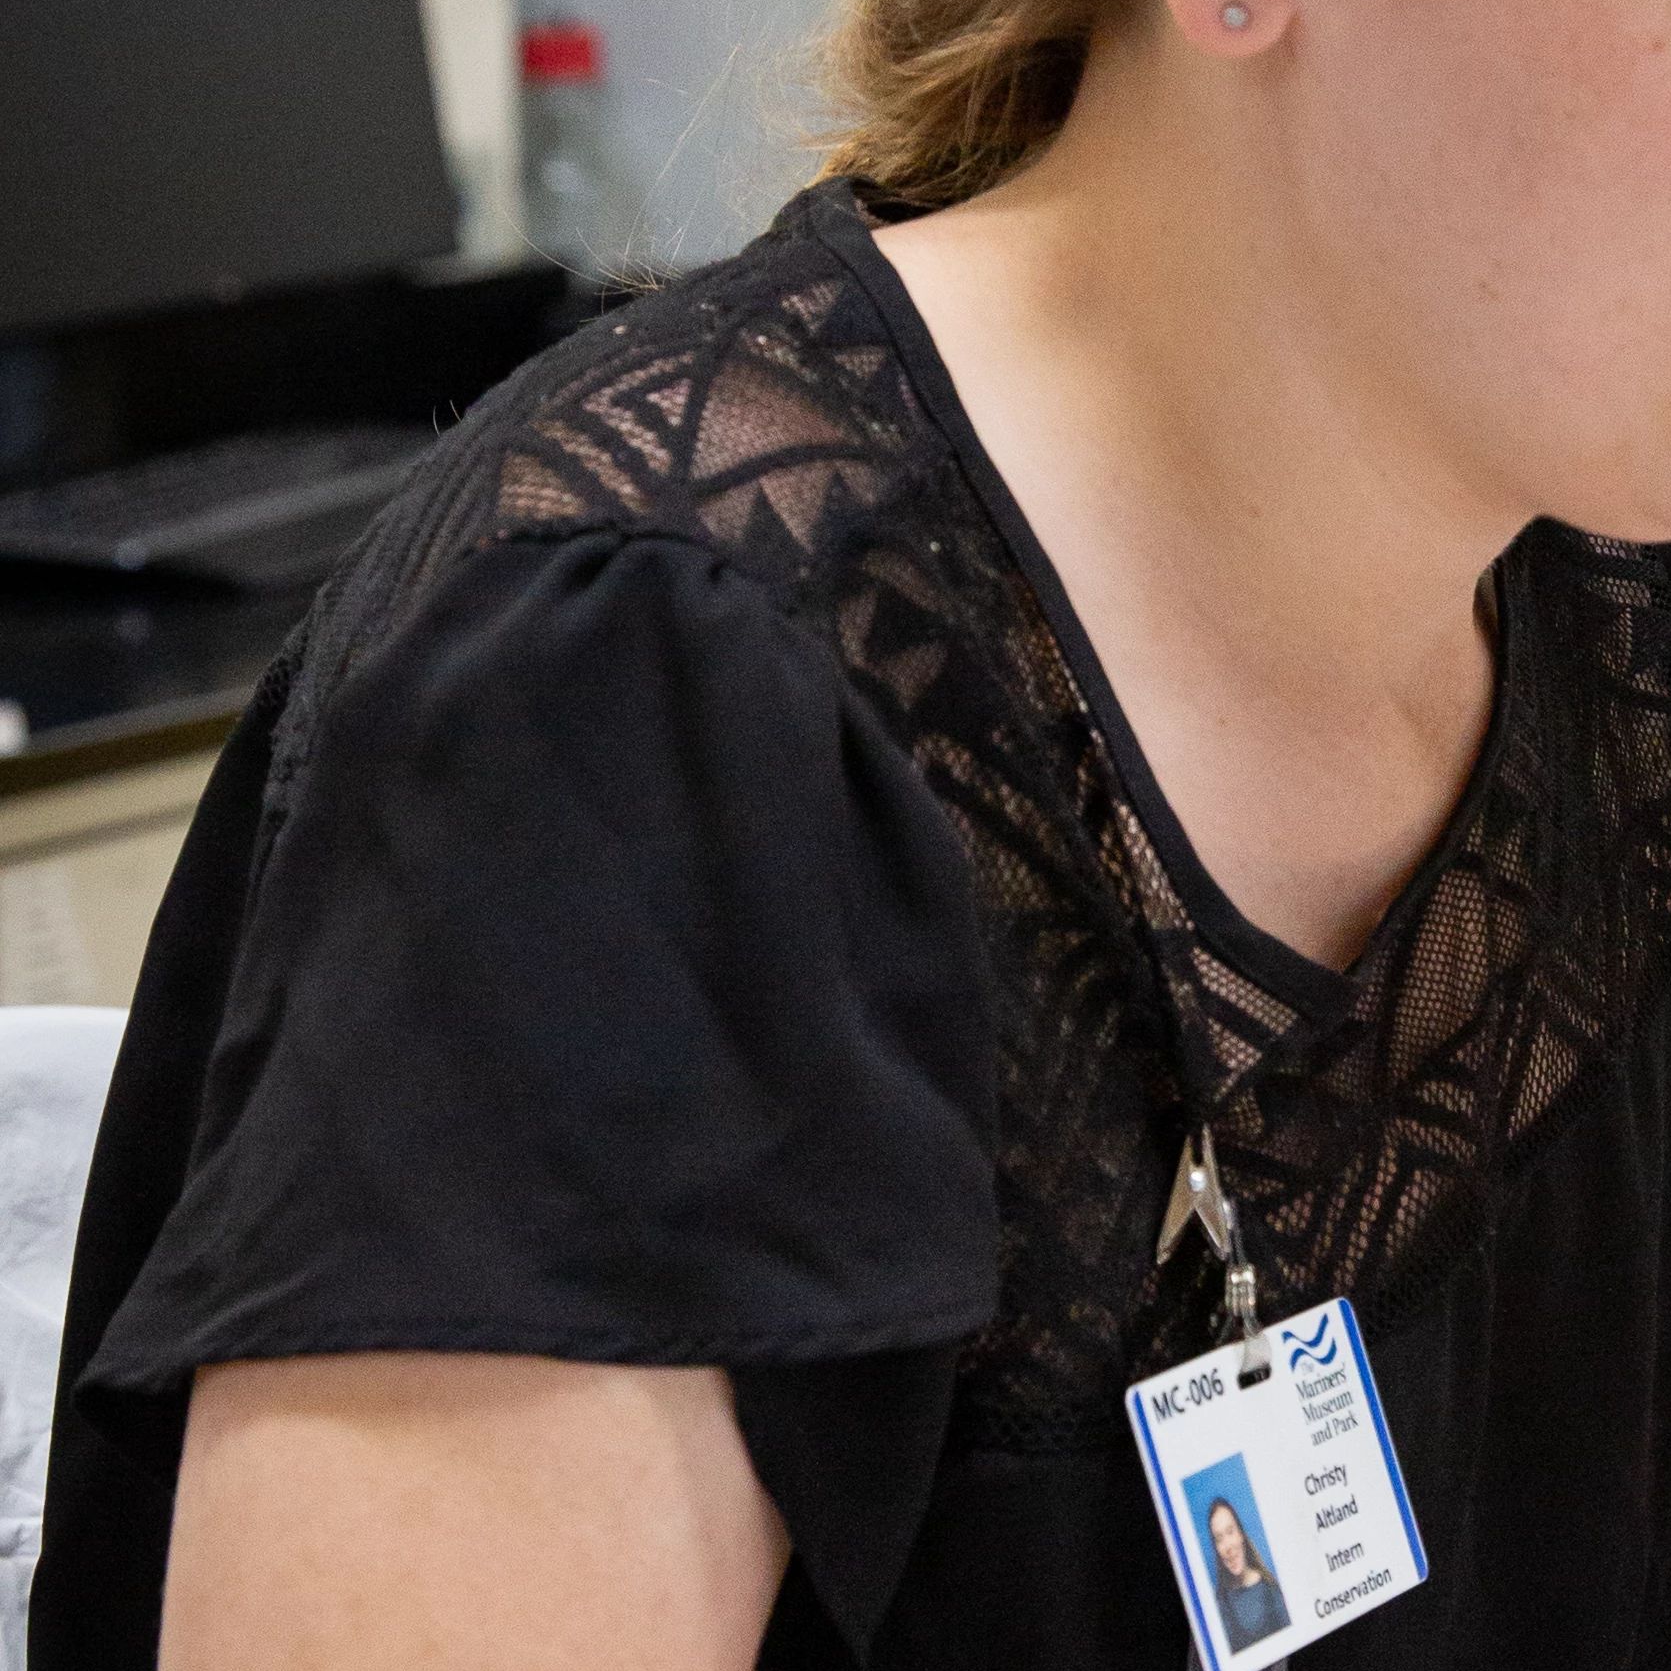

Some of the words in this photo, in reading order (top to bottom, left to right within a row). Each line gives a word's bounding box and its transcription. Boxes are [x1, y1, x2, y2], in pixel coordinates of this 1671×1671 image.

[1151, 1368, 1225, 1422] MC-006
[1302, 1391, 1354, 1425] Museum
[1310, 1421, 1333, 1447] and
[1332, 1410, 1359, 1436] Park
[1304, 1463, 1348, 1495] Christy
[1315, 1494, 1359, 1533] Altland
[1325, 1542, 1365, 1573] Intern
[1314, 1568, 1392, 1619] Conservation
